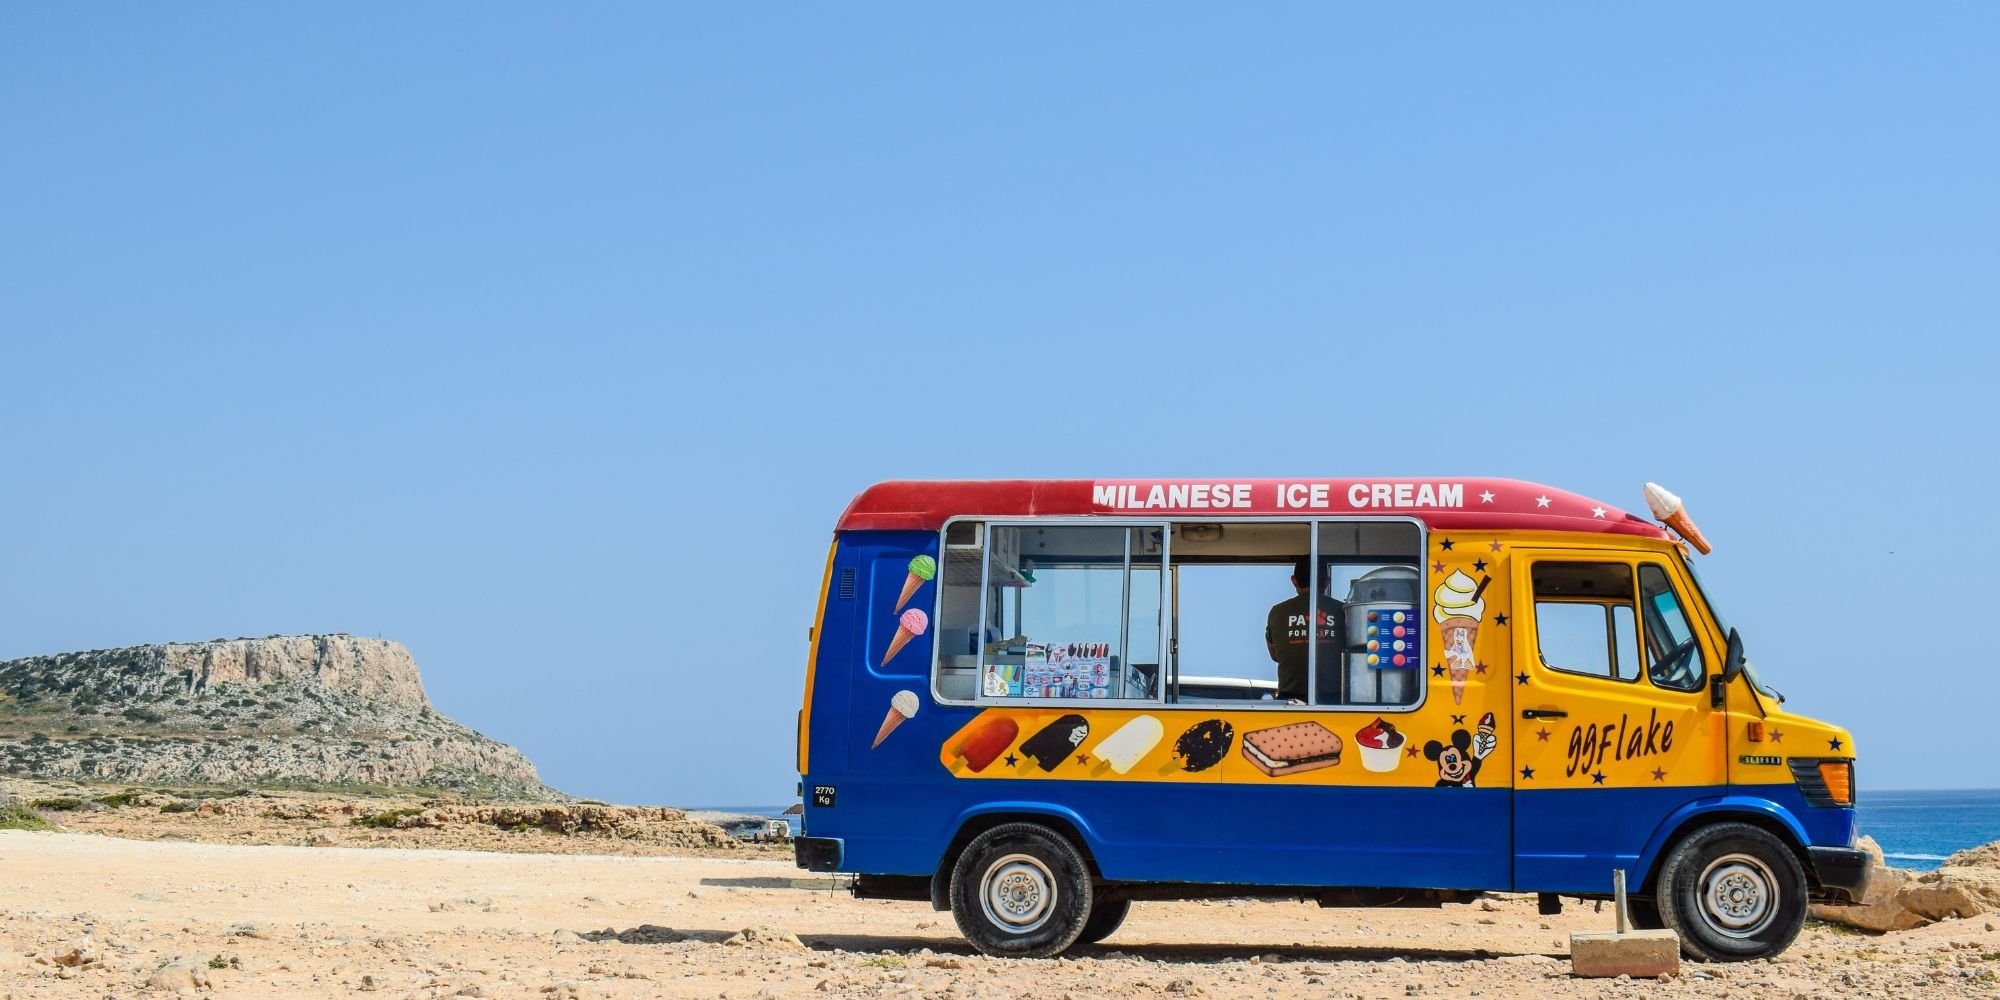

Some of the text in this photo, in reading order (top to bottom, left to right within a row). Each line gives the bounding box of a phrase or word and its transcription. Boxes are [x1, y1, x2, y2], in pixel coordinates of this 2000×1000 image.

[1093, 484, 1464, 508] MILANESE ICE CREAM
[1288, 614, 1335, 626] PAS
[815, 786, 834, 794] 2770
[819, 795, 829, 804] Kg
